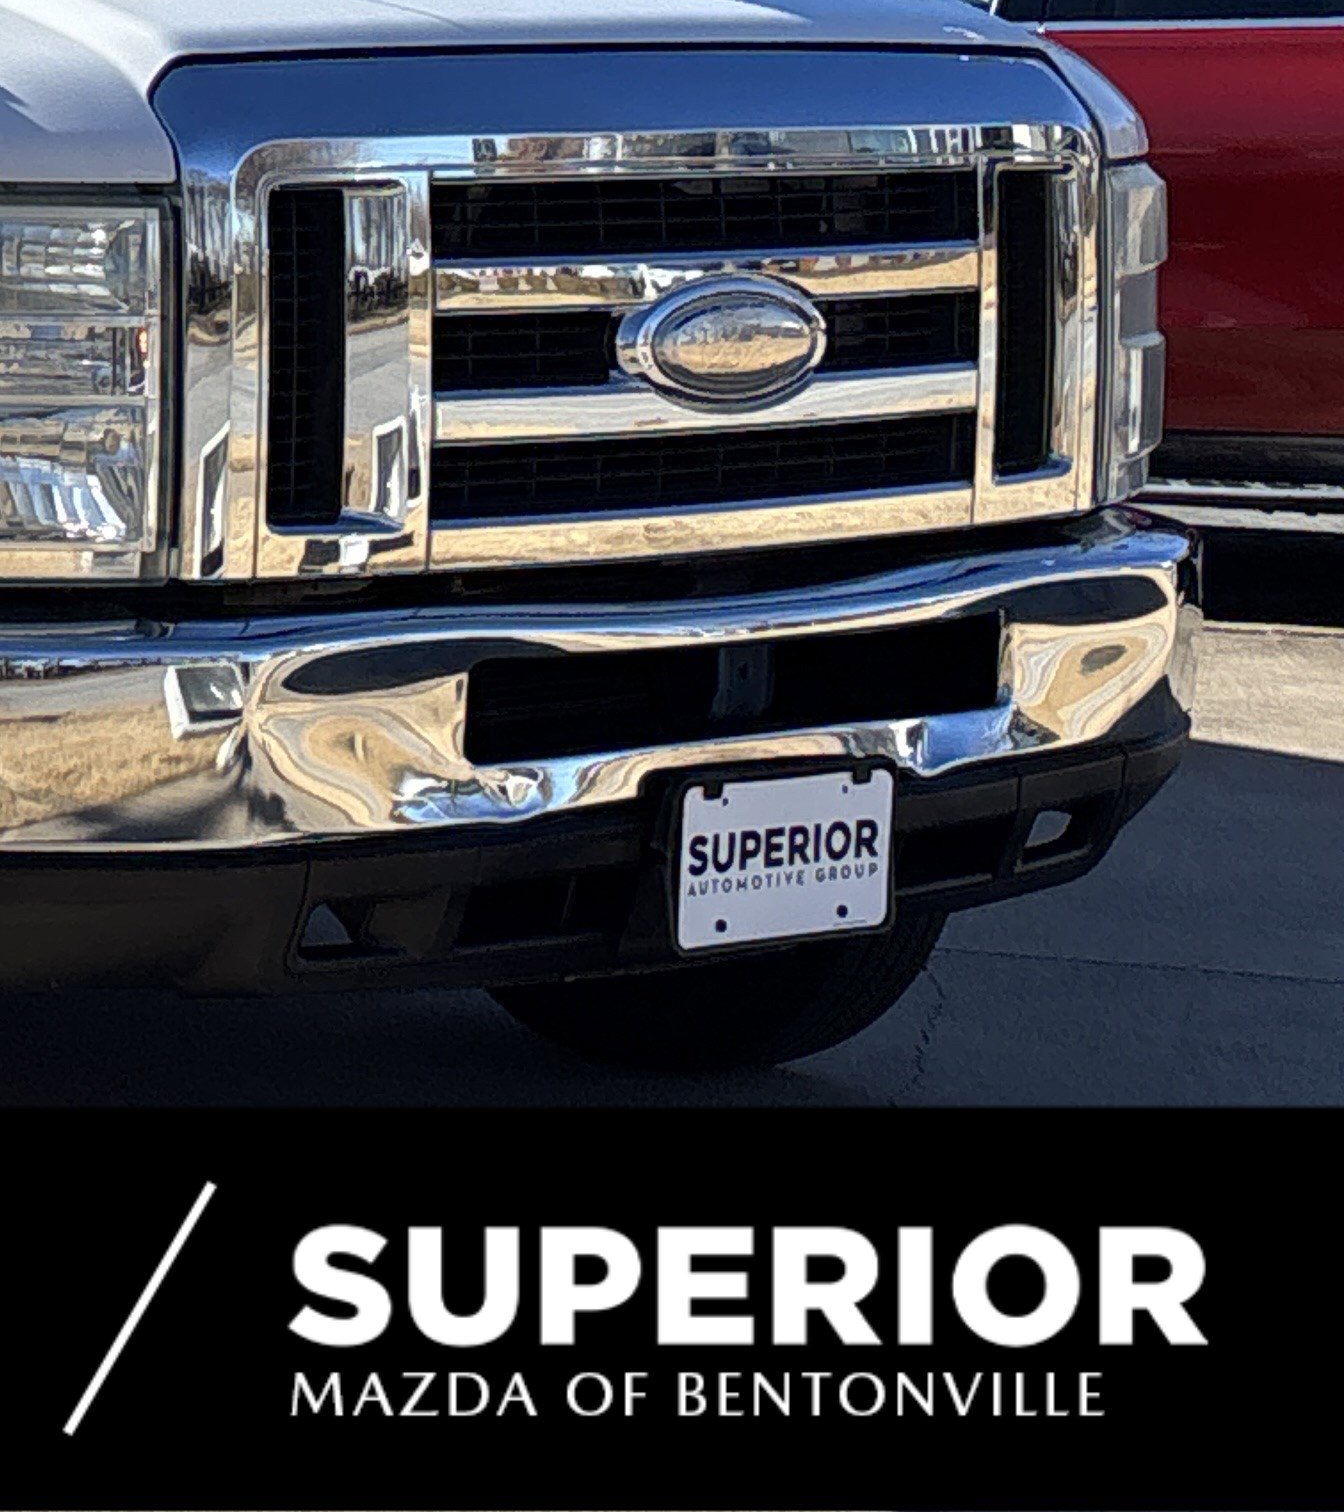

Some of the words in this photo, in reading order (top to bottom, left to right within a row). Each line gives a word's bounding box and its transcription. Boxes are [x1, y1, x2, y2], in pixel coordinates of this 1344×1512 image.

[688, 818, 879, 877] SUPERIOR
[687, 869, 806, 897] AUTOMOTIVE
[814, 862, 879, 883] GROUP
